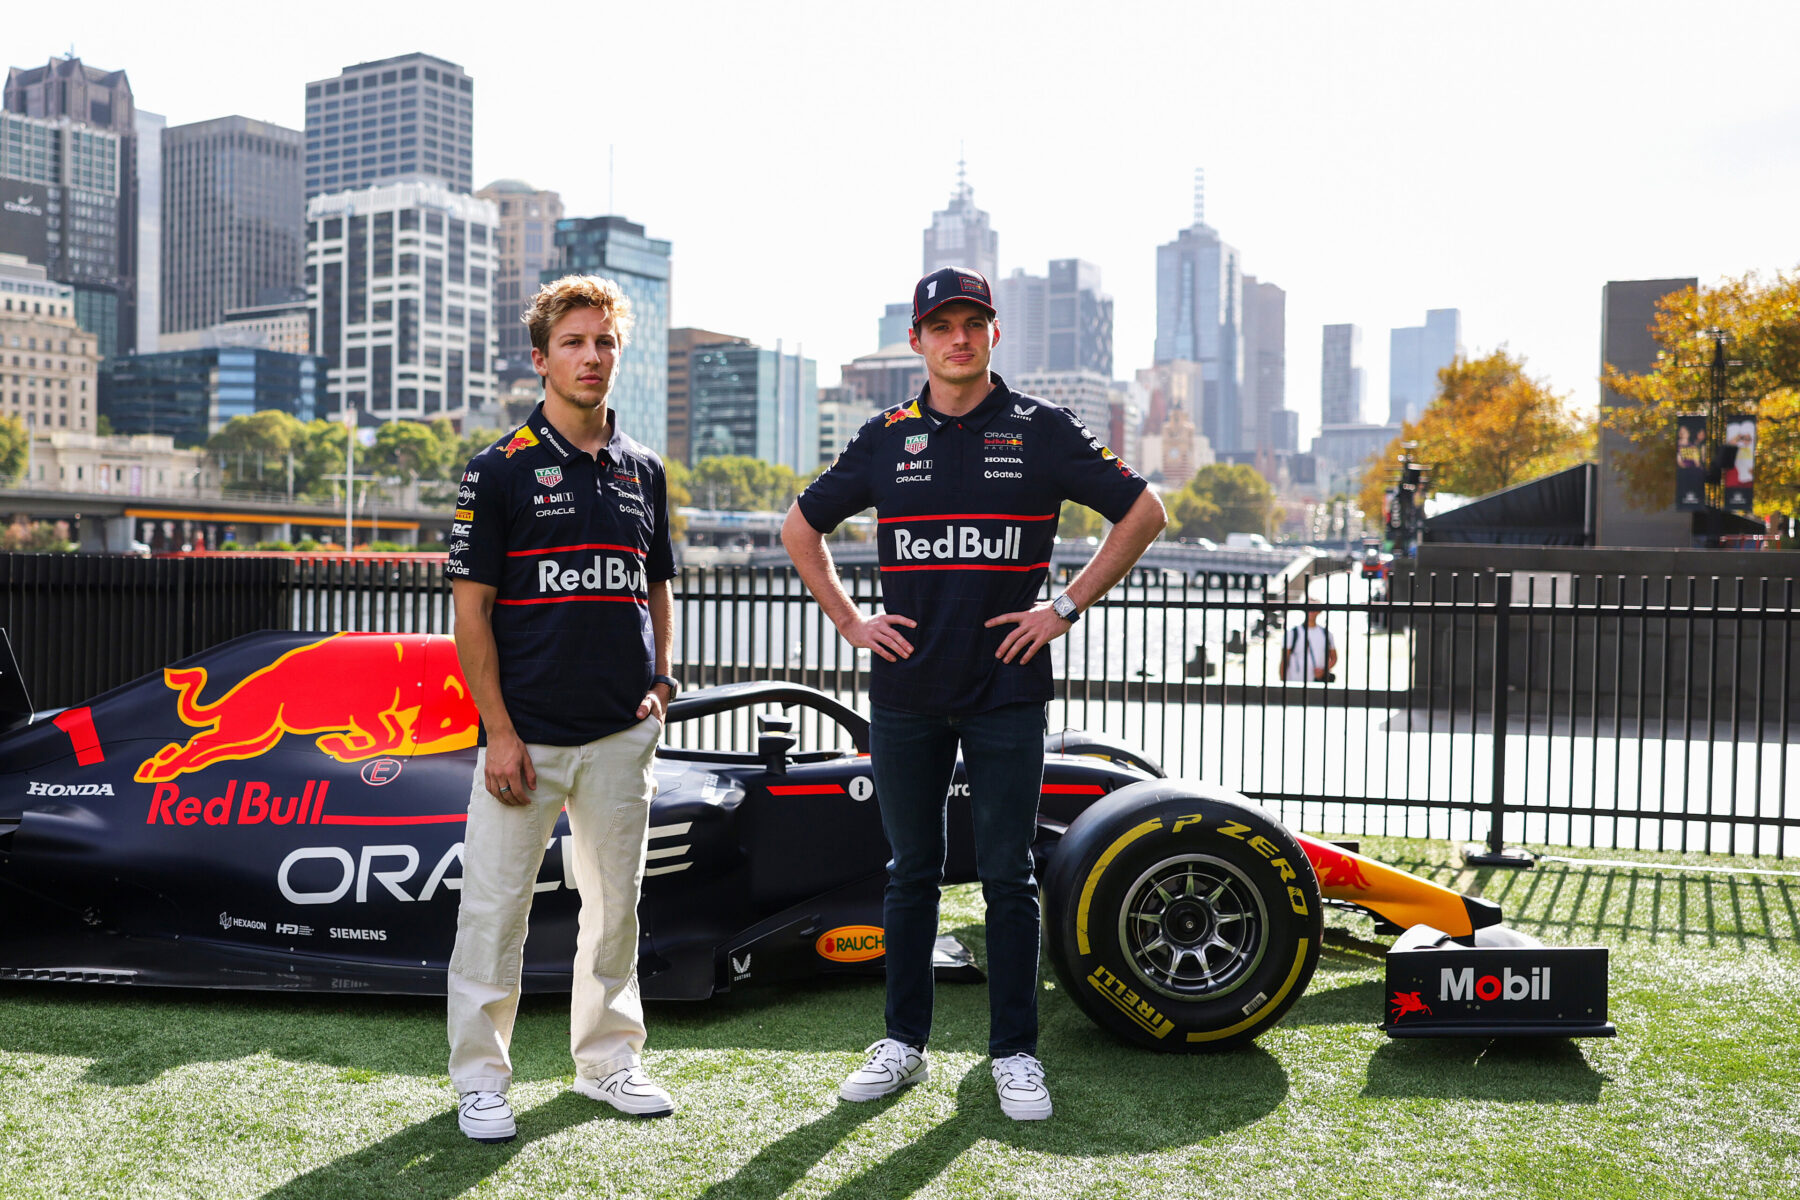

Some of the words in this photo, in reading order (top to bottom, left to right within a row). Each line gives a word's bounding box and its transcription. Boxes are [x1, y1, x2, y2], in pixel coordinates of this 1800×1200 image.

[926, 280, 938, 299] 1
[907, 435, 926, 444] TAG
[896, 460, 922, 471] Mobil
[895, 474, 932, 483] ORACLE
[992, 470, 1022, 478] Gate.io
[534, 493, 563, 505] Mobil
[535, 507, 575, 517] ORACLE
[894, 525, 954, 560] Red
[959, 526, 1022, 560] Bull
[52, 706, 105, 767] 1
[26, 781, 115, 797] HONDA
[146, 779, 238, 826] Red
[237, 779, 330, 826] Bull
[1216, 819, 1309, 916] ZERO
[233, 917, 267, 930] HEXAGON
[329, 927, 387, 941] SIEMENS
[836, 935, 885, 952] RAUCH
[1440, 967, 1551, 1001] Mobil
[1087, 965, 1175, 1039] PIRELLI
